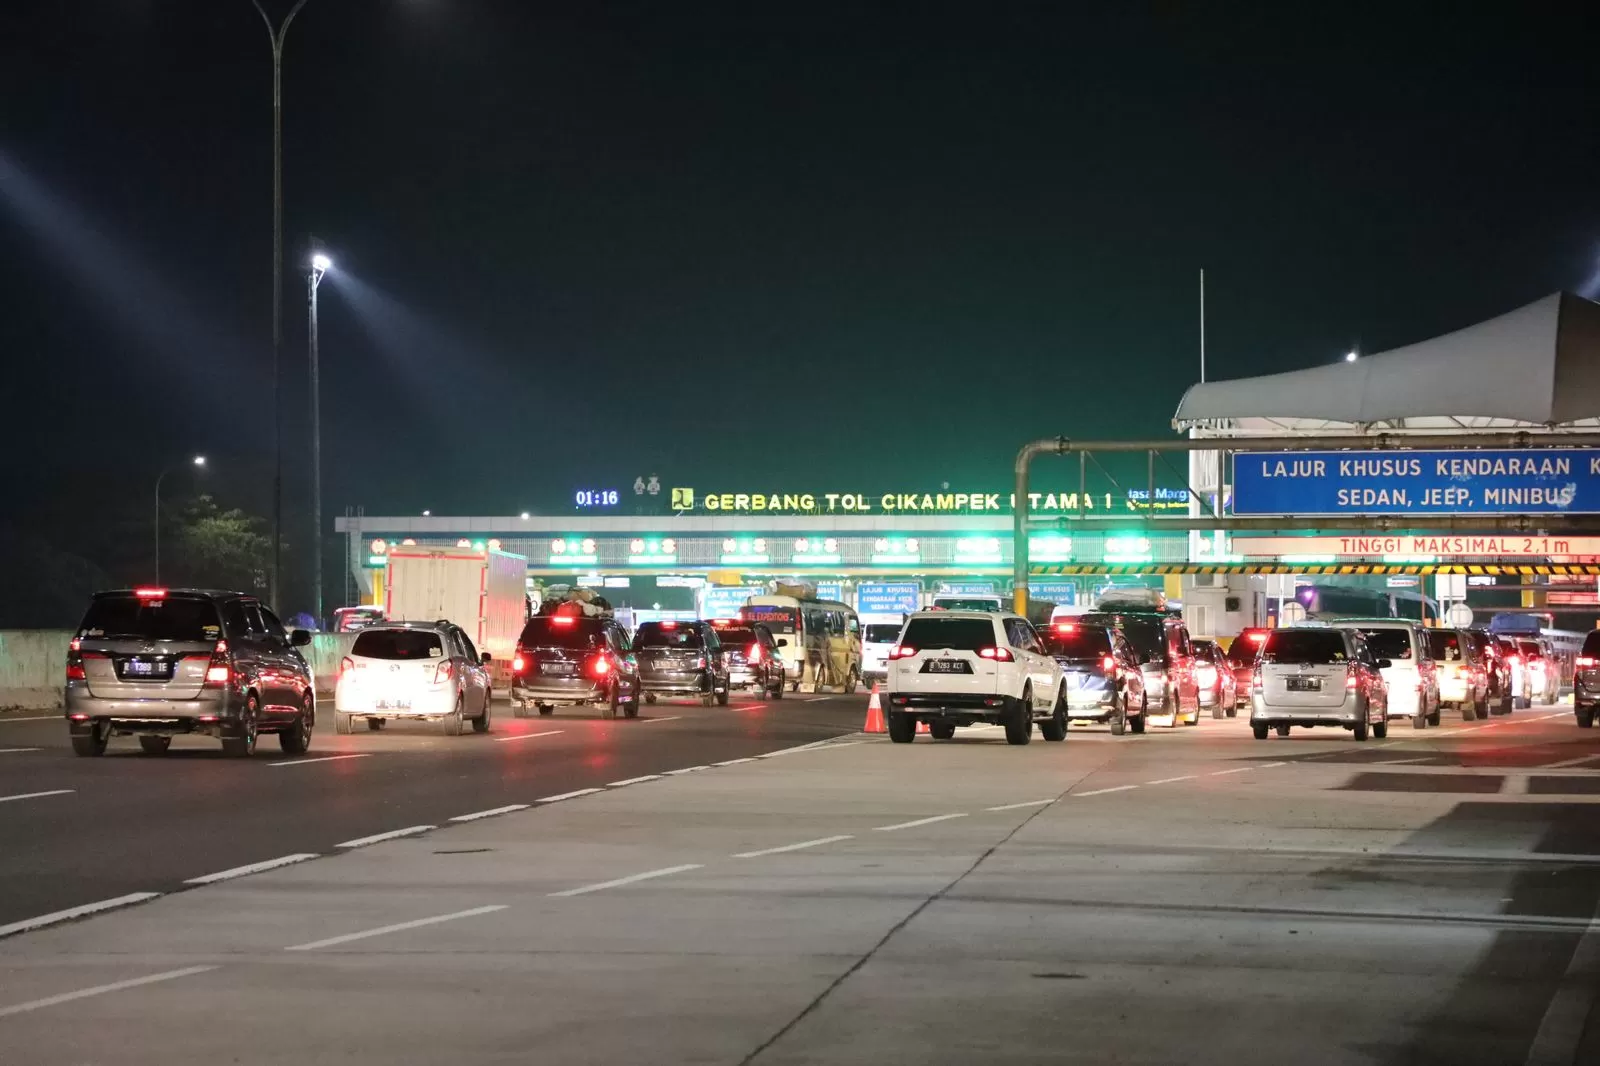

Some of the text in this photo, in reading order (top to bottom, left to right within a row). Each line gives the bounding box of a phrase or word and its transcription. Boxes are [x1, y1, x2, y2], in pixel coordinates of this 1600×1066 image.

[1262, 459, 1326, 478] LAJUR
[1339, 458, 1421, 477] KHUSUS
[1436, 457, 1570, 476] KENDARAAN
[576, 490, 618, 505] 01:16
[704, 493, 815, 511] GERBANG
[826, 493, 870, 511] TOL
[881, 493, 1000, 511] CIKAMPEK
[1337, 486, 1571, 508] SEDAN, JEEP, MINIBUS
[1340, 538, 1401, 553] TINGGI
